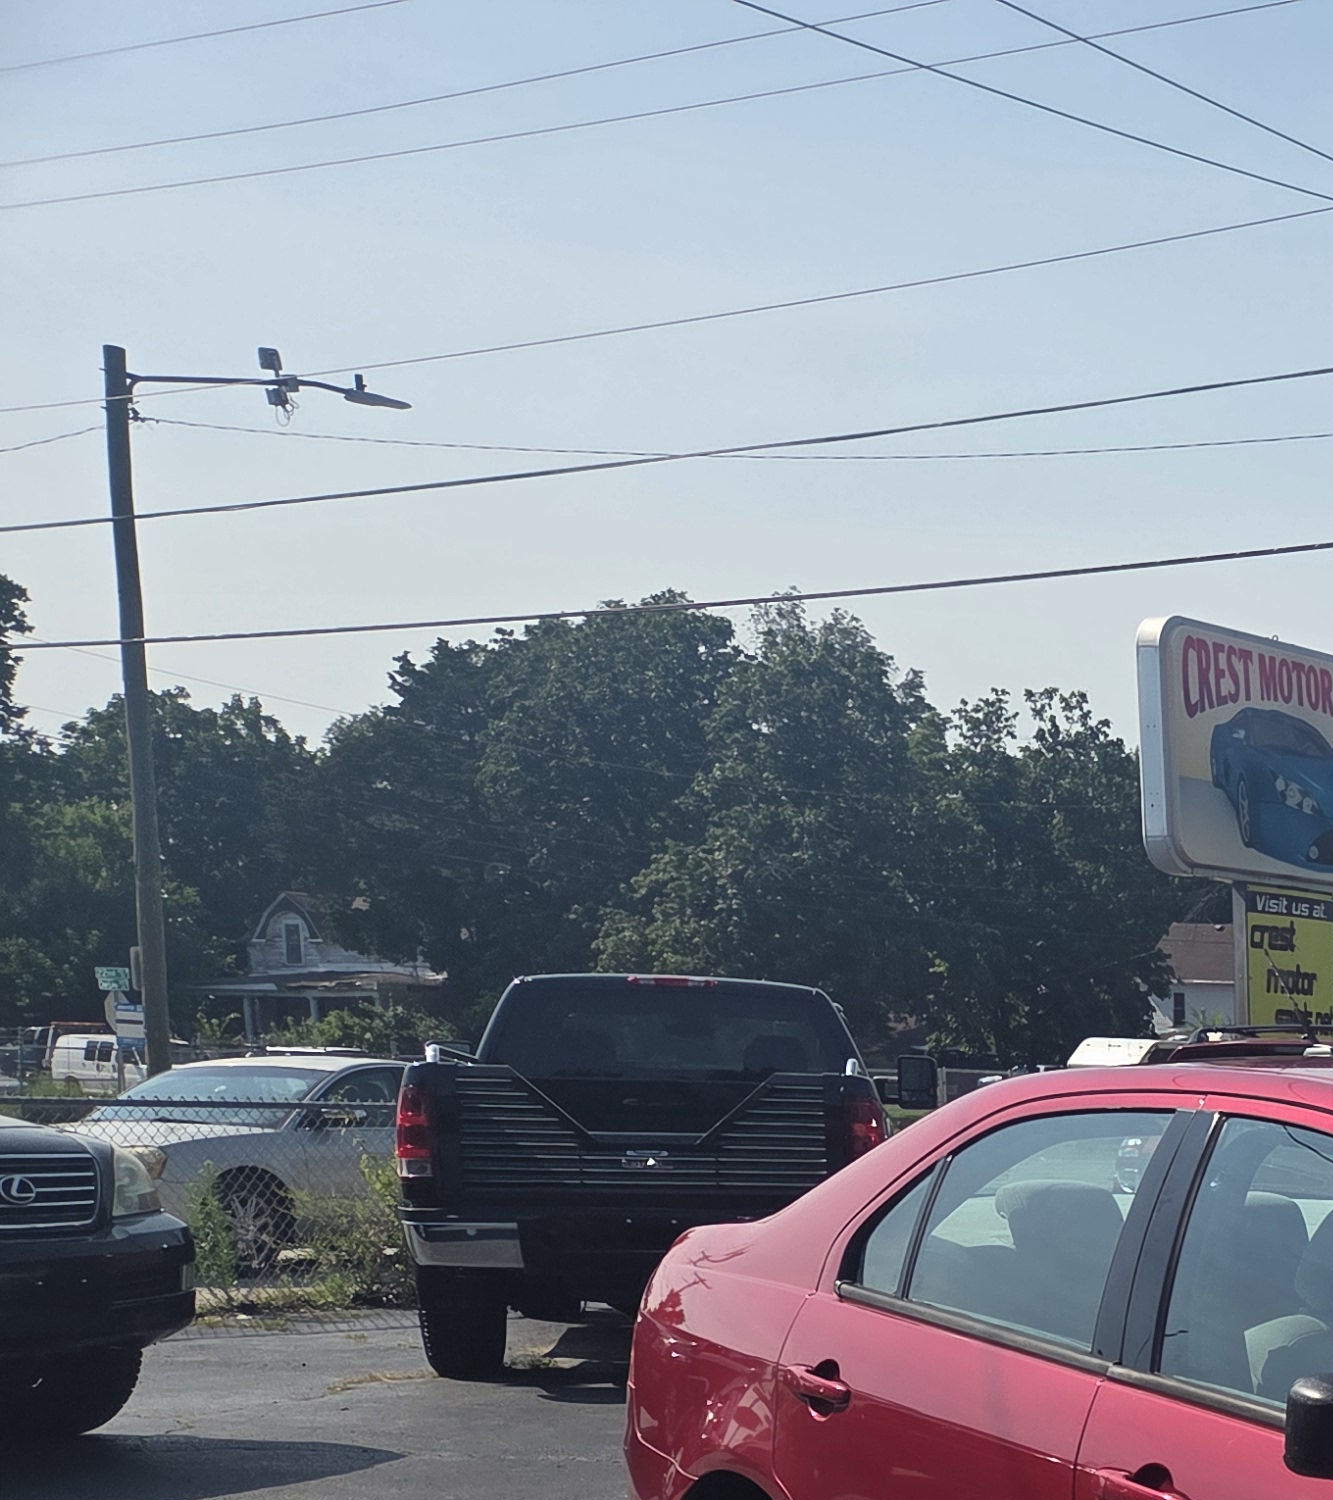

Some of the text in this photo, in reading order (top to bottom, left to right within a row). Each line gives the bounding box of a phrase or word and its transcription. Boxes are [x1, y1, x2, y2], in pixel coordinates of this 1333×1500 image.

[1181, 635, 1253, 719] CREST
[1256, 894, 1288, 914] Visit
[1291, 901, 1310, 917] us
[1250, 920, 1296, 952] crest
[1266, 964, 1318, 996] motor
